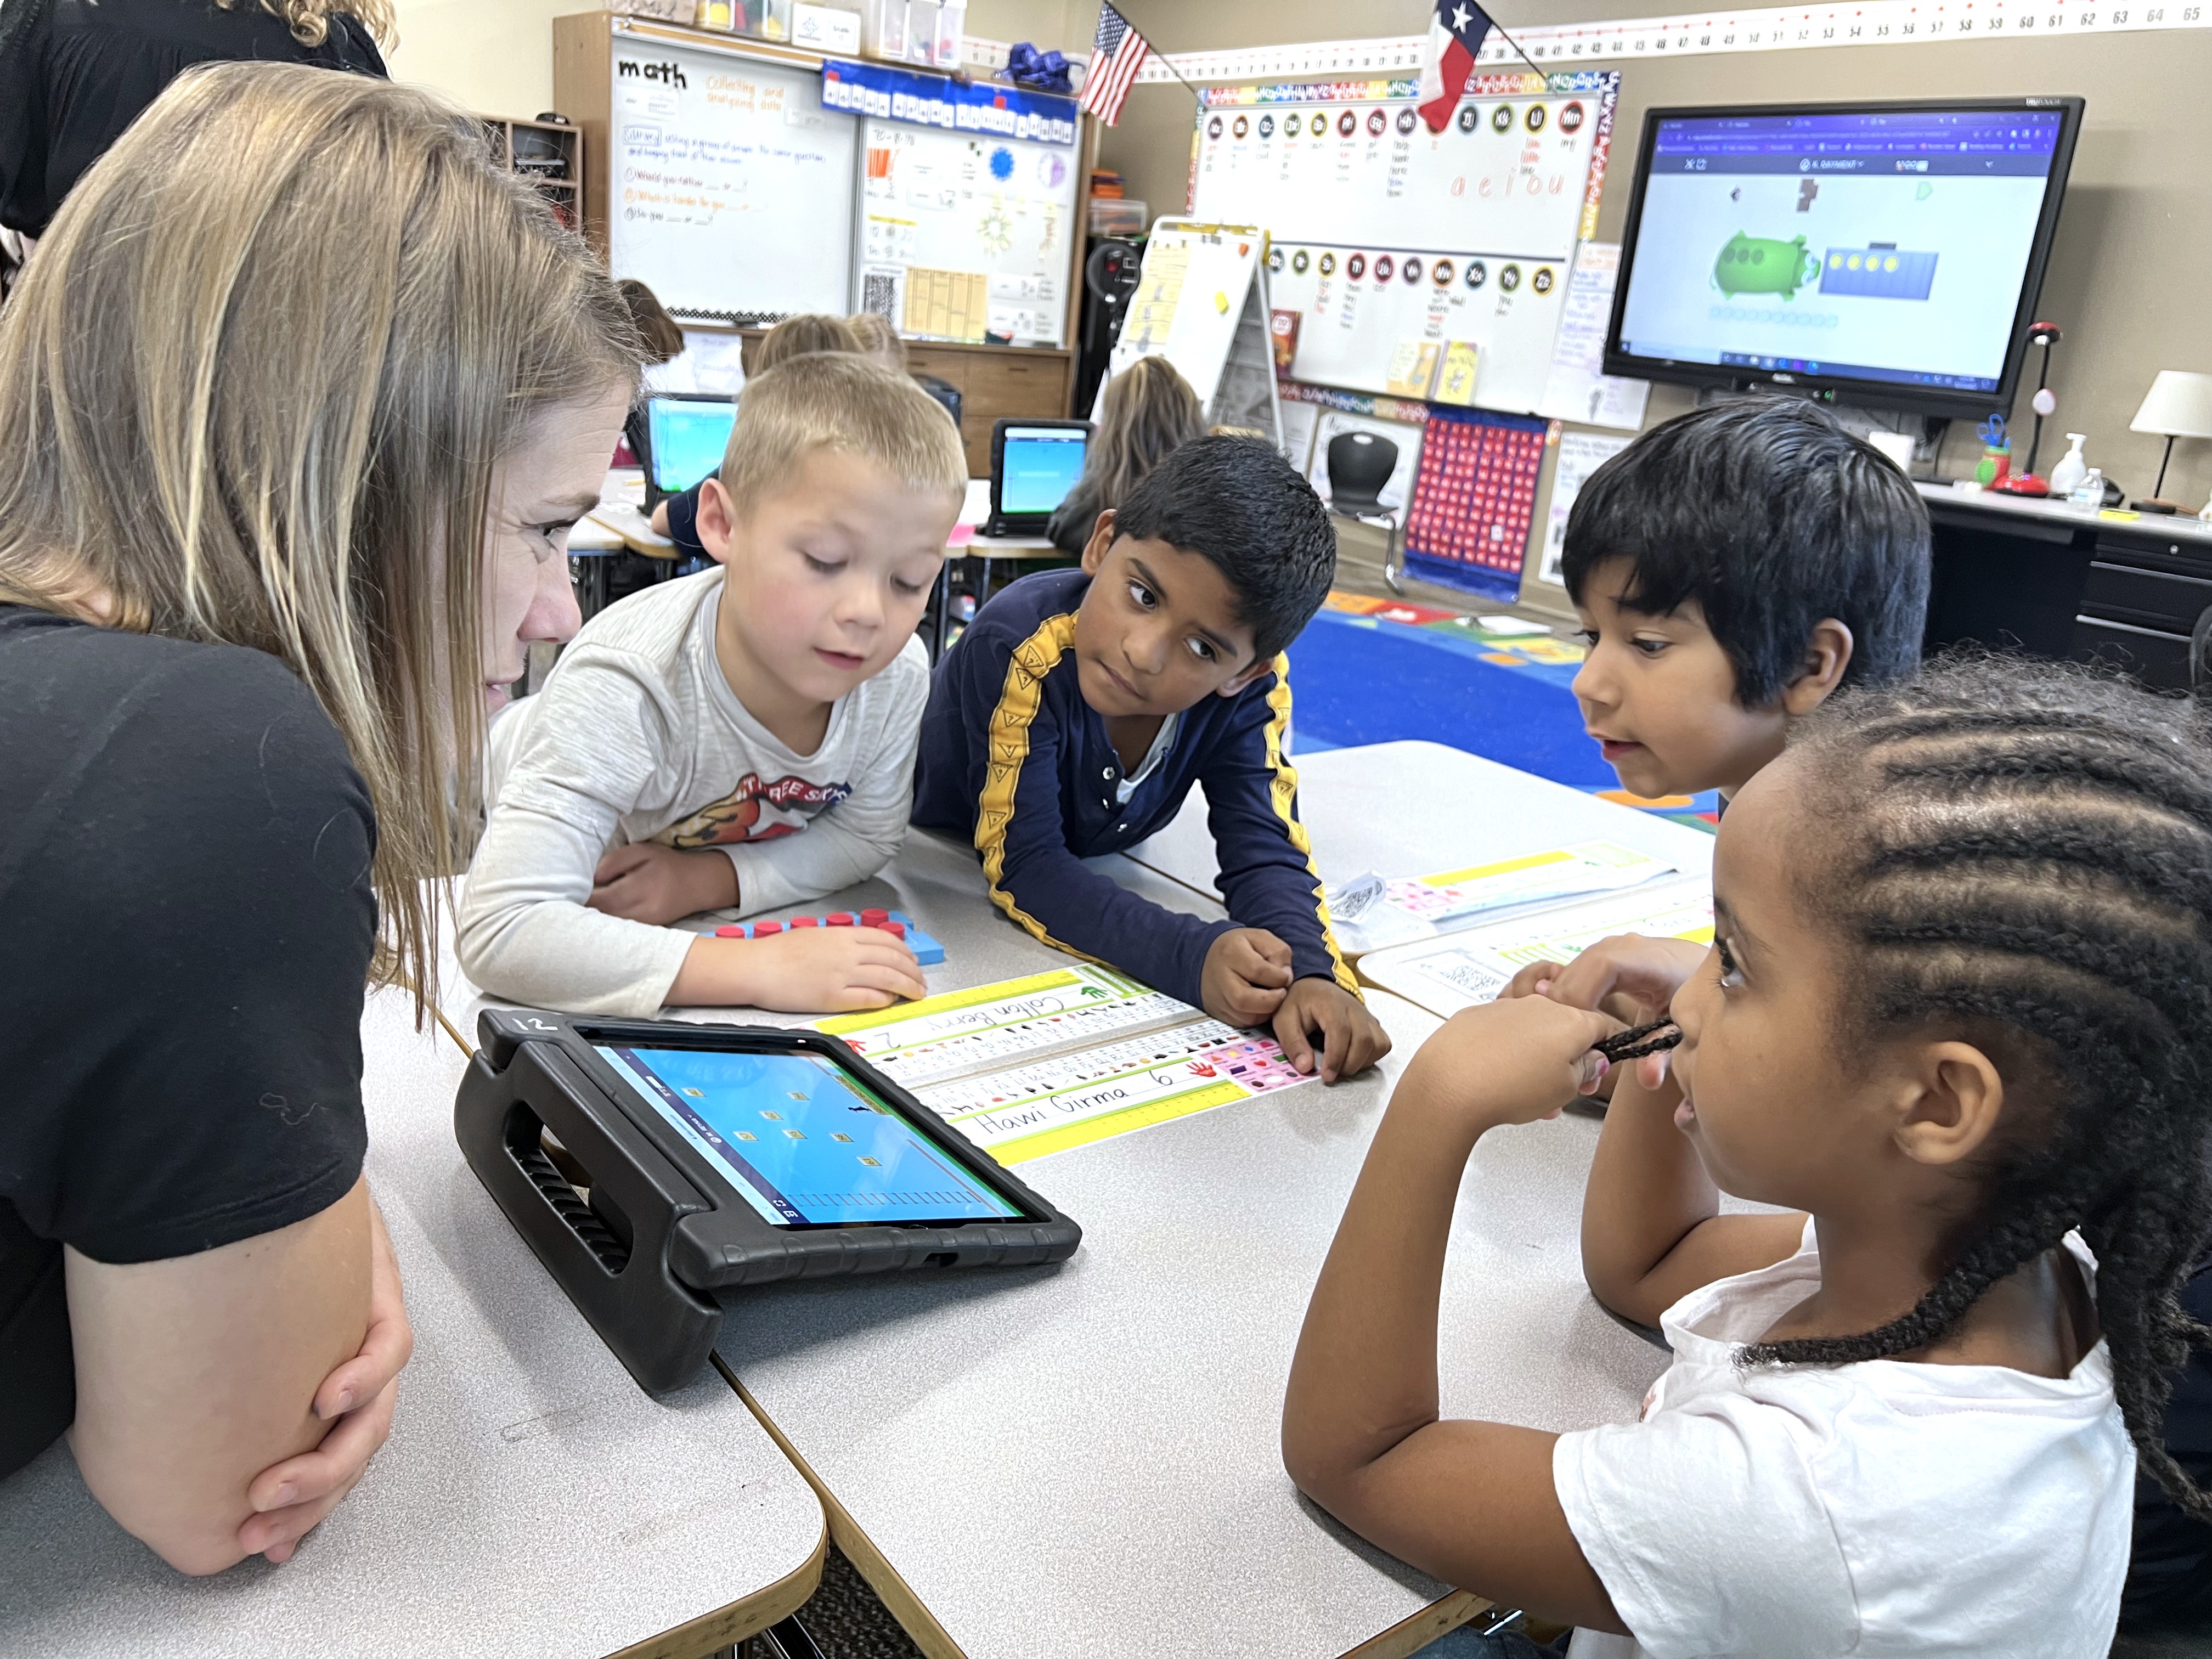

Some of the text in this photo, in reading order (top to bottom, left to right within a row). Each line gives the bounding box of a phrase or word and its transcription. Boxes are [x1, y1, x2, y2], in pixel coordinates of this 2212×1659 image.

[1571, 43, 1583, 55] 42
[1591, 42, 1603, 53] 43
[1656, 38, 1667, 49] 46
[1678, 36, 1689, 48] 47
[1700, 35, 1711, 46] 48
[1931, 20, 1944, 33] 57
[2019, 15, 2034, 29] 60
[2049, 14, 2063, 28] 61
[2081, 12, 2096, 26] 62
[2113, 10, 2129, 24] 63
[2147, 8, 2164, 23] 64
[2183, 7, 2201, 21] 65
[619, 60, 688, 89] math
[1451, 176, 1466, 198] a
[1479, 176, 1493, 198] e
[1526, 174, 1543, 195] o
[1548, 174, 1565, 195] u
[512, 1018, 558, 1030] 12
[873, 996, 1065, 1049] Colton Berry 2
[973, 1070, 1173, 1135] Hawi Girma 6
